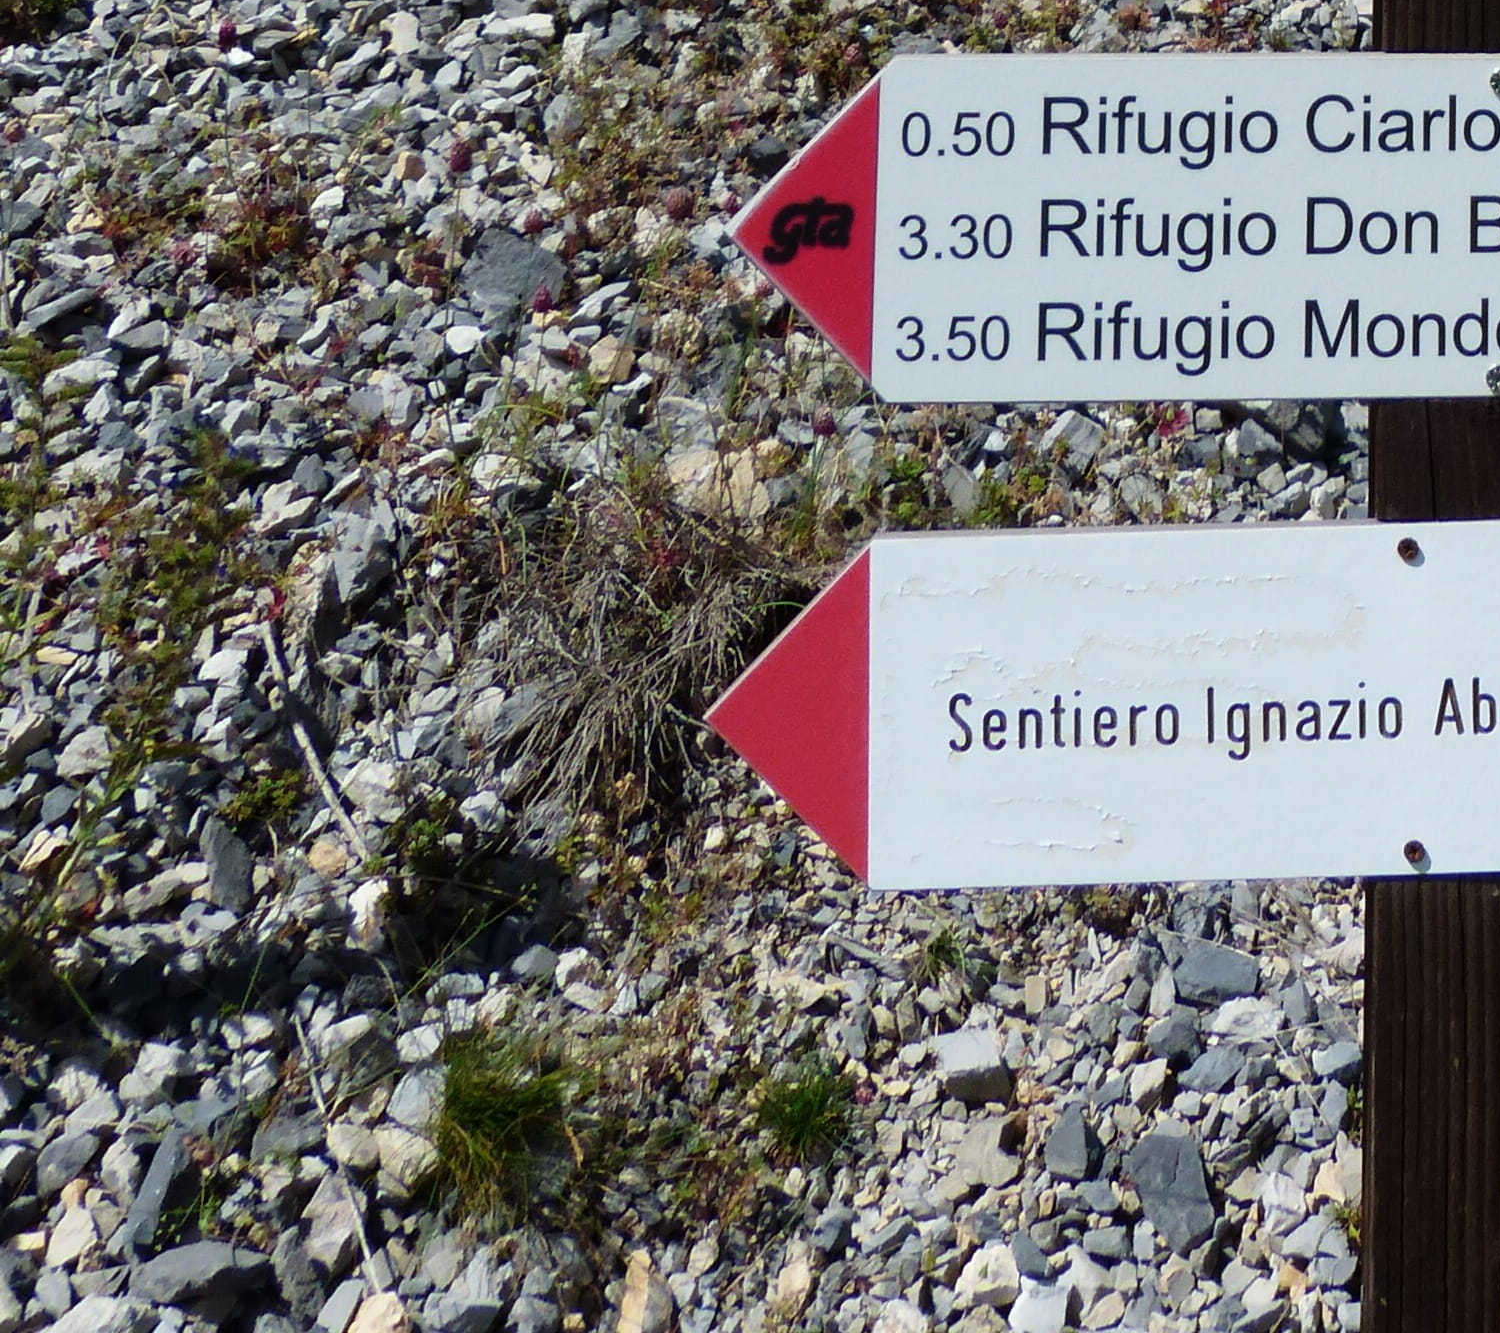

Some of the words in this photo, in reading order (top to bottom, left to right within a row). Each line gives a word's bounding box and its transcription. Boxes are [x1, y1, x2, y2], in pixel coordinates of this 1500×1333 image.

[901, 111, 1015, 158] 0.50
[1042, 95, 1279, 170] Rifugio
[898, 213, 1013, 261] 3.30
[1039, 197, 1277, 273] Rifugio
[1306, 196, 1439, 255] Don
[895, 315, 1010, 362] 3.50
[1037, 300, 1275, 377] Rifugio
[948, 689, 1180, 753] Sentiero
[1207, 681, 1403, 761] Ignazio
